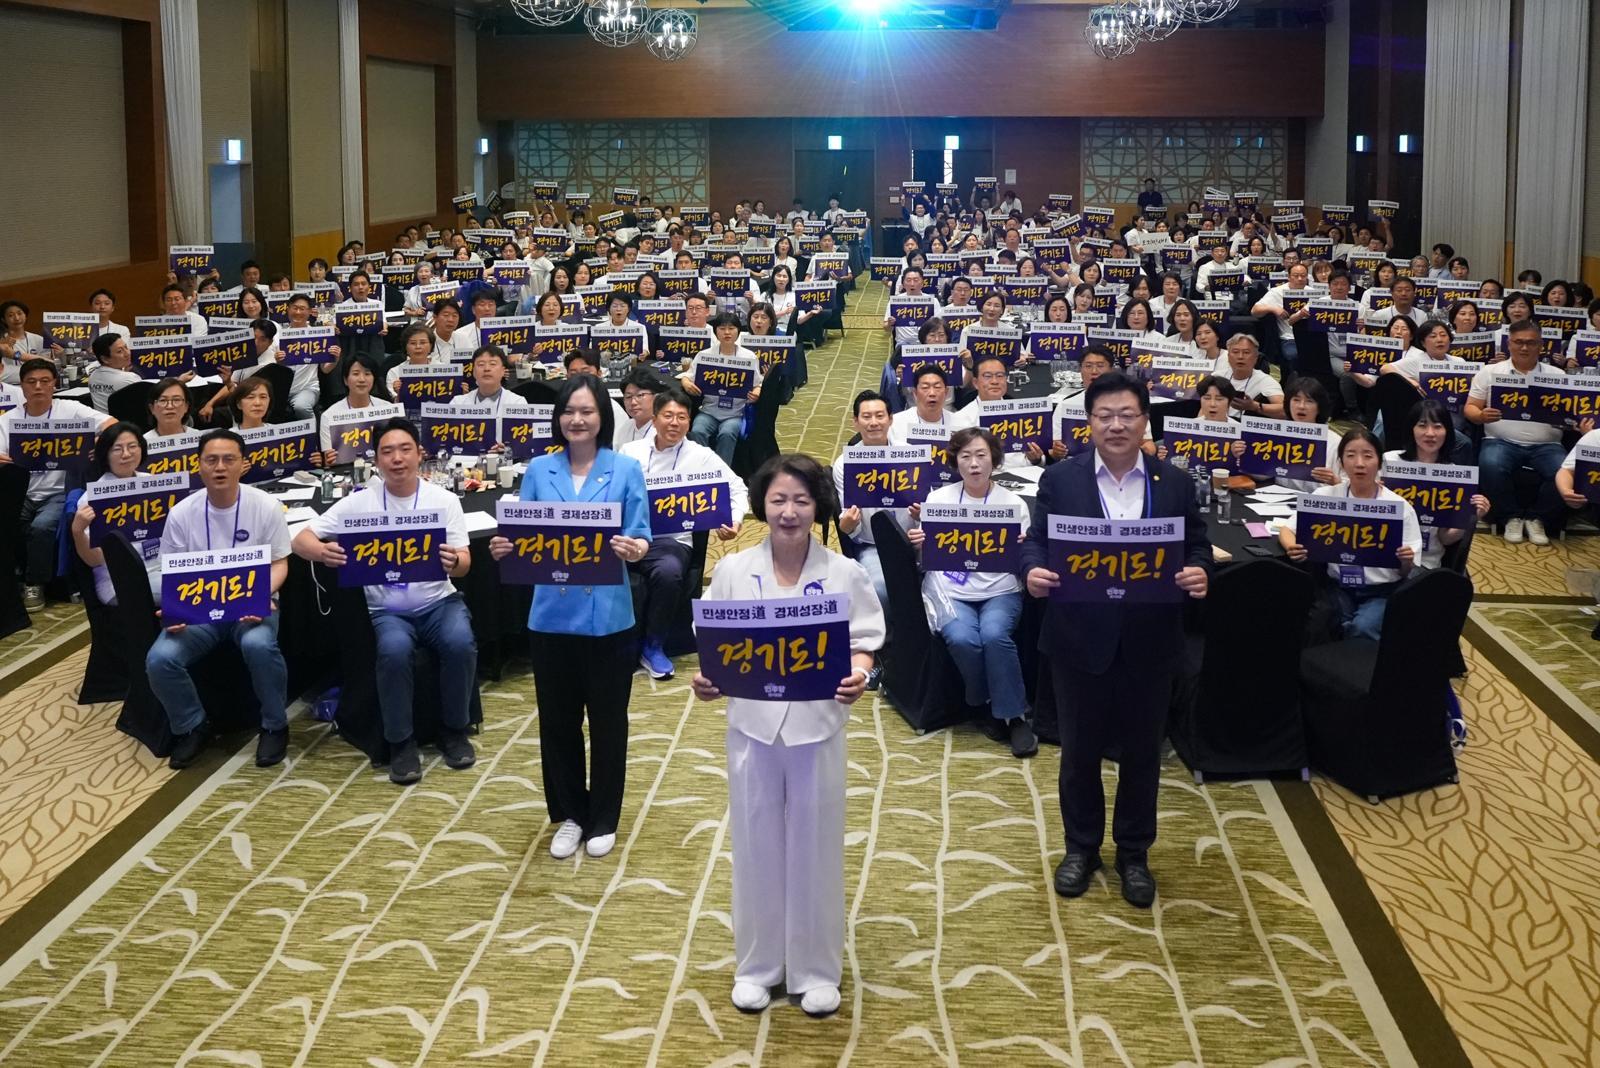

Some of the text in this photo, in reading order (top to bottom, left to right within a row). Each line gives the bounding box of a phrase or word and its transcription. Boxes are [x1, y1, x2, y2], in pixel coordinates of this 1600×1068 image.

[1315, 310, 1351, 324] 경기도!
[52, 326, 91, 339] 경기도!
[488, 329, 528, 344] 경기도!
[203, 343, 247, 362] 경기도!
[287, 340, 327, 354] 경기도!
[541, 337, 580, 352] 경기도!
[598, 339, 636, 353] 경기도!
[666, 340, 704, 355] 경기도!
[975, 340, 1014, 356] 경기도!
[1038, 336, 1078, 351] 경기도!
[139, 349, 184, 368] 경기도!
[1354, 349, 1395, 366] 경기도!
[408, 379, 454, 396] 경기도!
[704, 370, 744, 388] 경기도!
[1541, 394, 1600, 416] 경기도!
[430, 423, 486, 443] 경기도!
[990, 418, 1042, 444] 경기도!
[20, 436, 83, 458] 경기도!
[250, 438, 306, 468] 경기도!
[1252, 438, 1313, 465] 경기도!
[855, 466, 918, 492] 경기도!
[656, 489, 717, 517] 경기도!
[1303, 500, 1397, 515] 민생안정道 경제성장道
[344, 512, 439, 527] 민생안정道 경제성장道
[503, 507, 612, 520] 민생안정道 경제성장道
[926, 508, 1014, 517] 민생안정道 경제성장道
[1056, 523, 1176, 536] 민생안정道 경제성장道
[1311, 522, 1388, 550] 경기도!
[515, 532, 602, 564] 경기도!
[934, 528, 1008, 554] 경기도!
[169, 550, 264, 568] 민생안정道 경제성장道
[353, 535, 430, 566] 경기도!
[1067, 548, 1165, 582] 경기도!
[177, 571, 256, 605] 경기도!
[702, 600, 838, 620] 민생안정道 경제성장道
[717, 631, 828, 676] 경기도!
